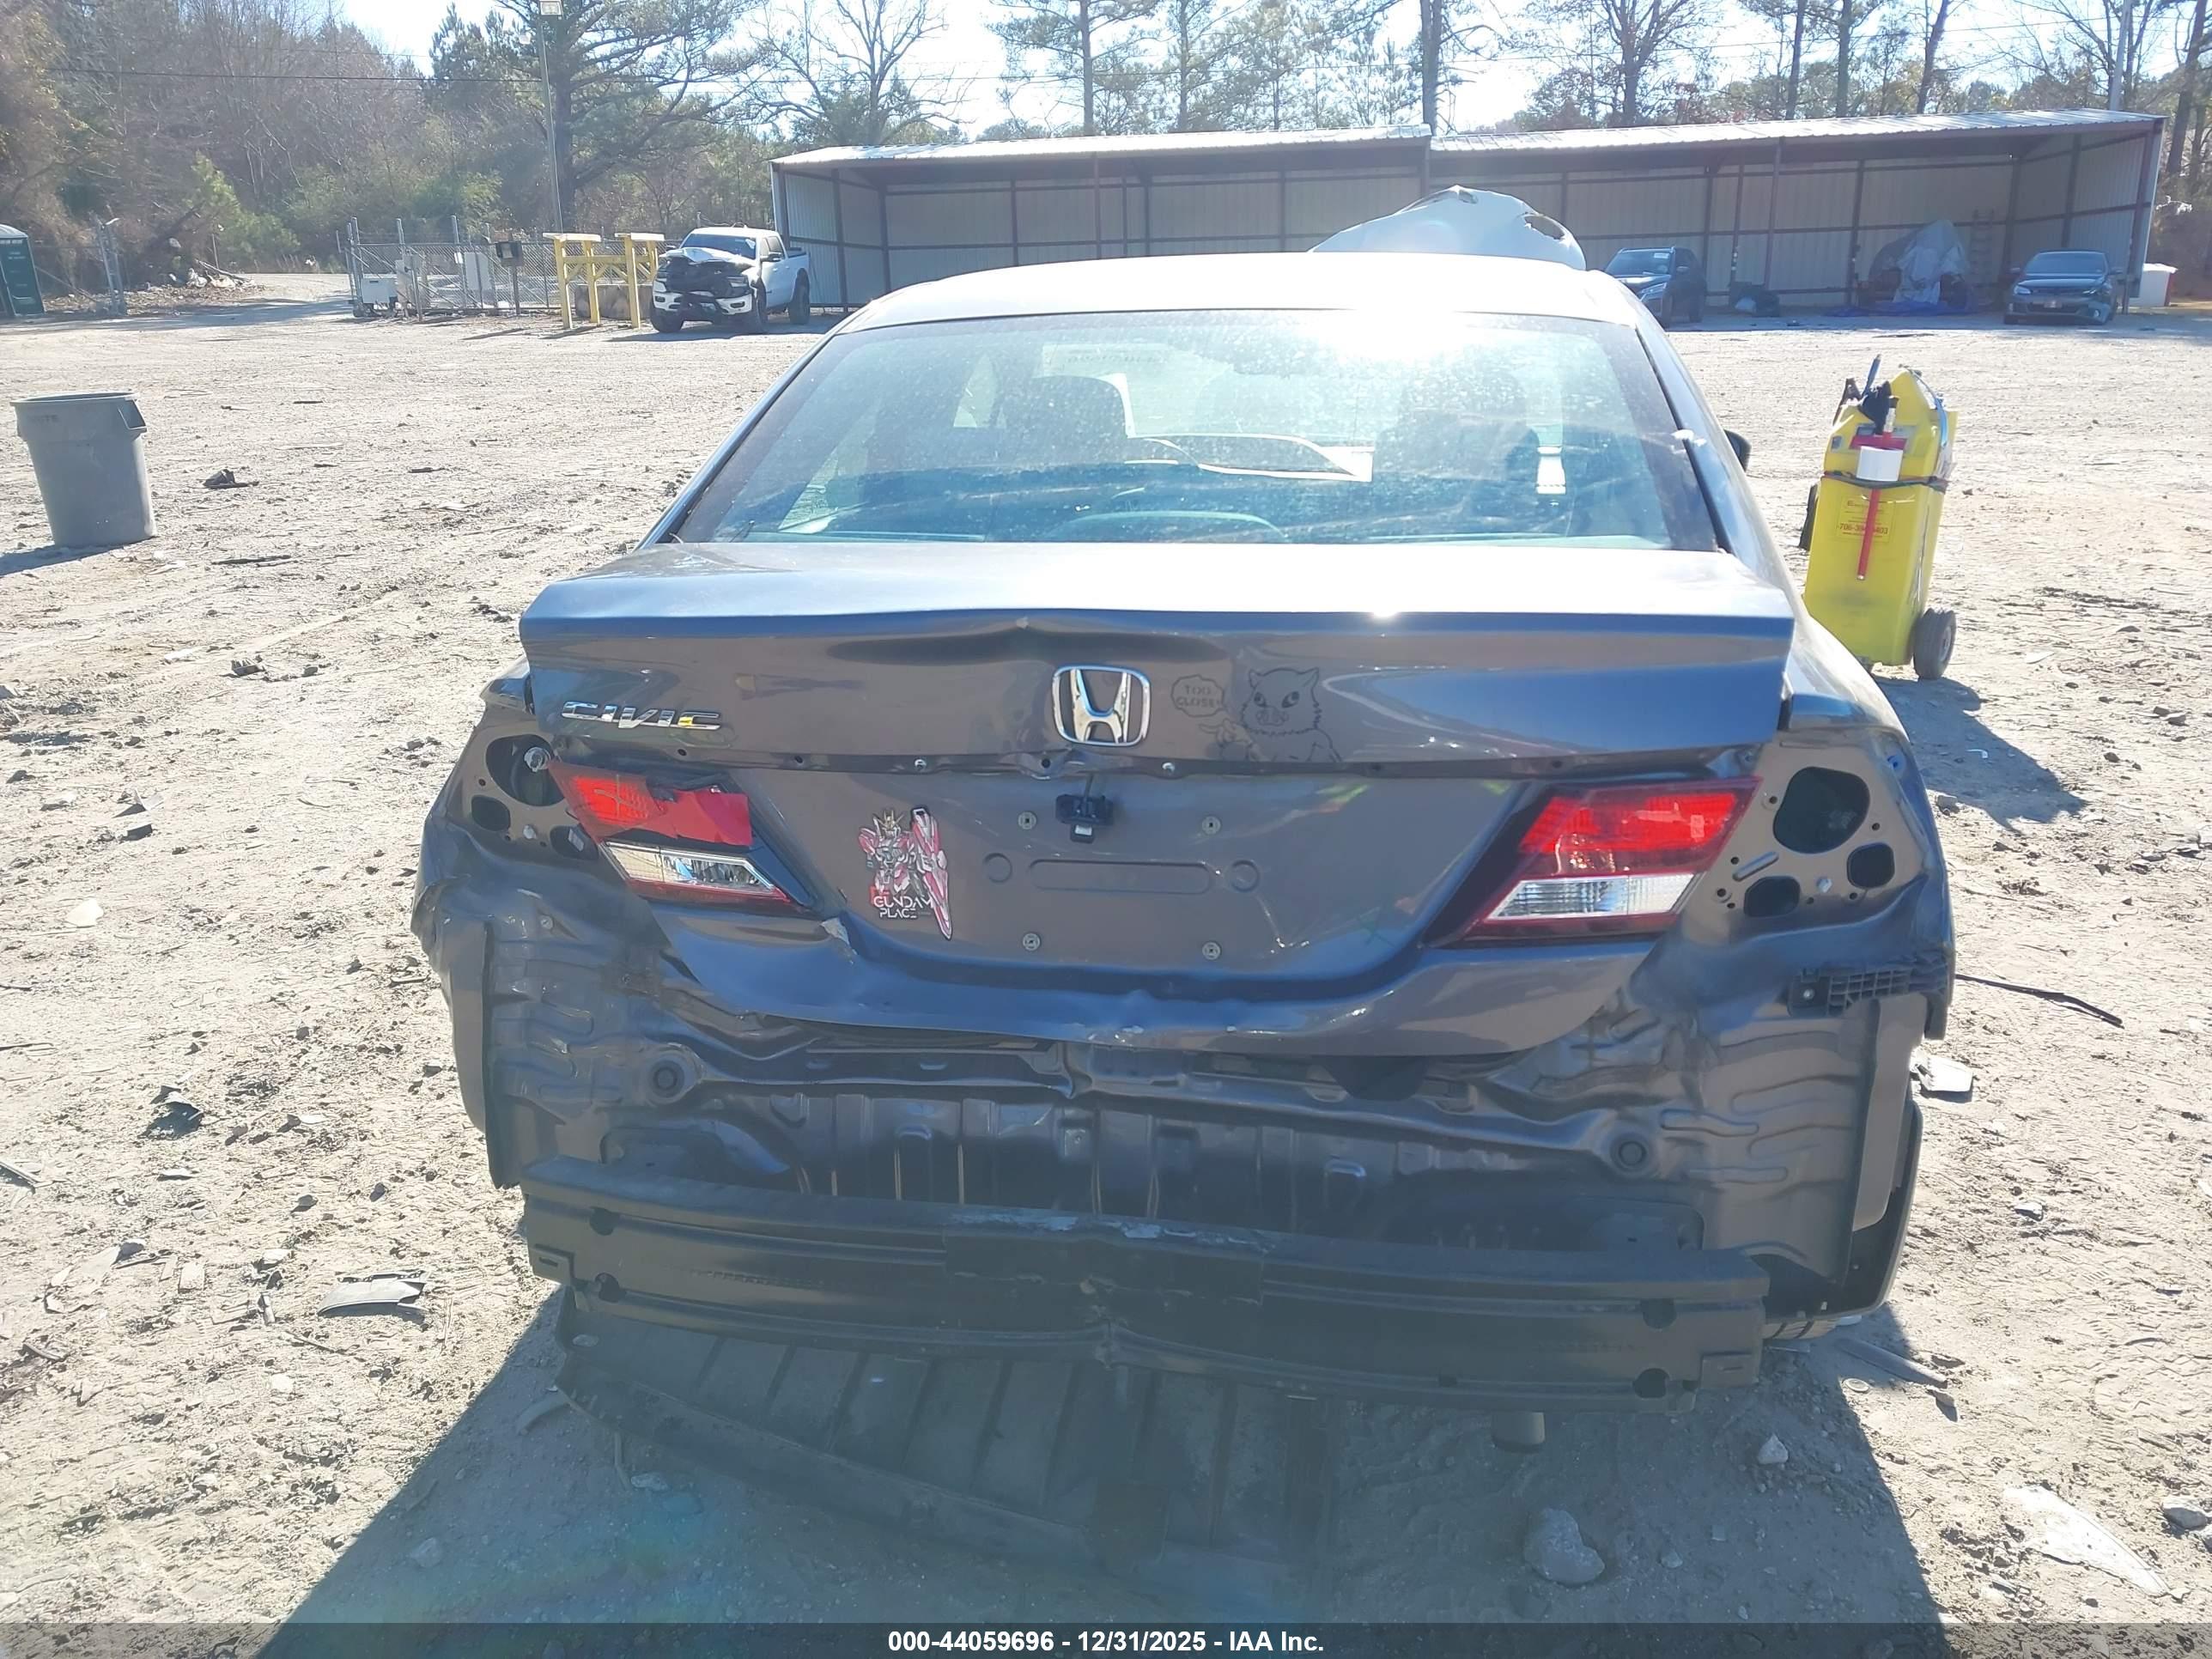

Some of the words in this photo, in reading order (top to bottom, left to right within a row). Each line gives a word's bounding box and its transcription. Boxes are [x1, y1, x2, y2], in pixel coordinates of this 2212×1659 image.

[562, 702, 720, 730] CIVIC
[873, 896, 933, 908] GUNDAM
[880, 908, 916, 918] PLACE
